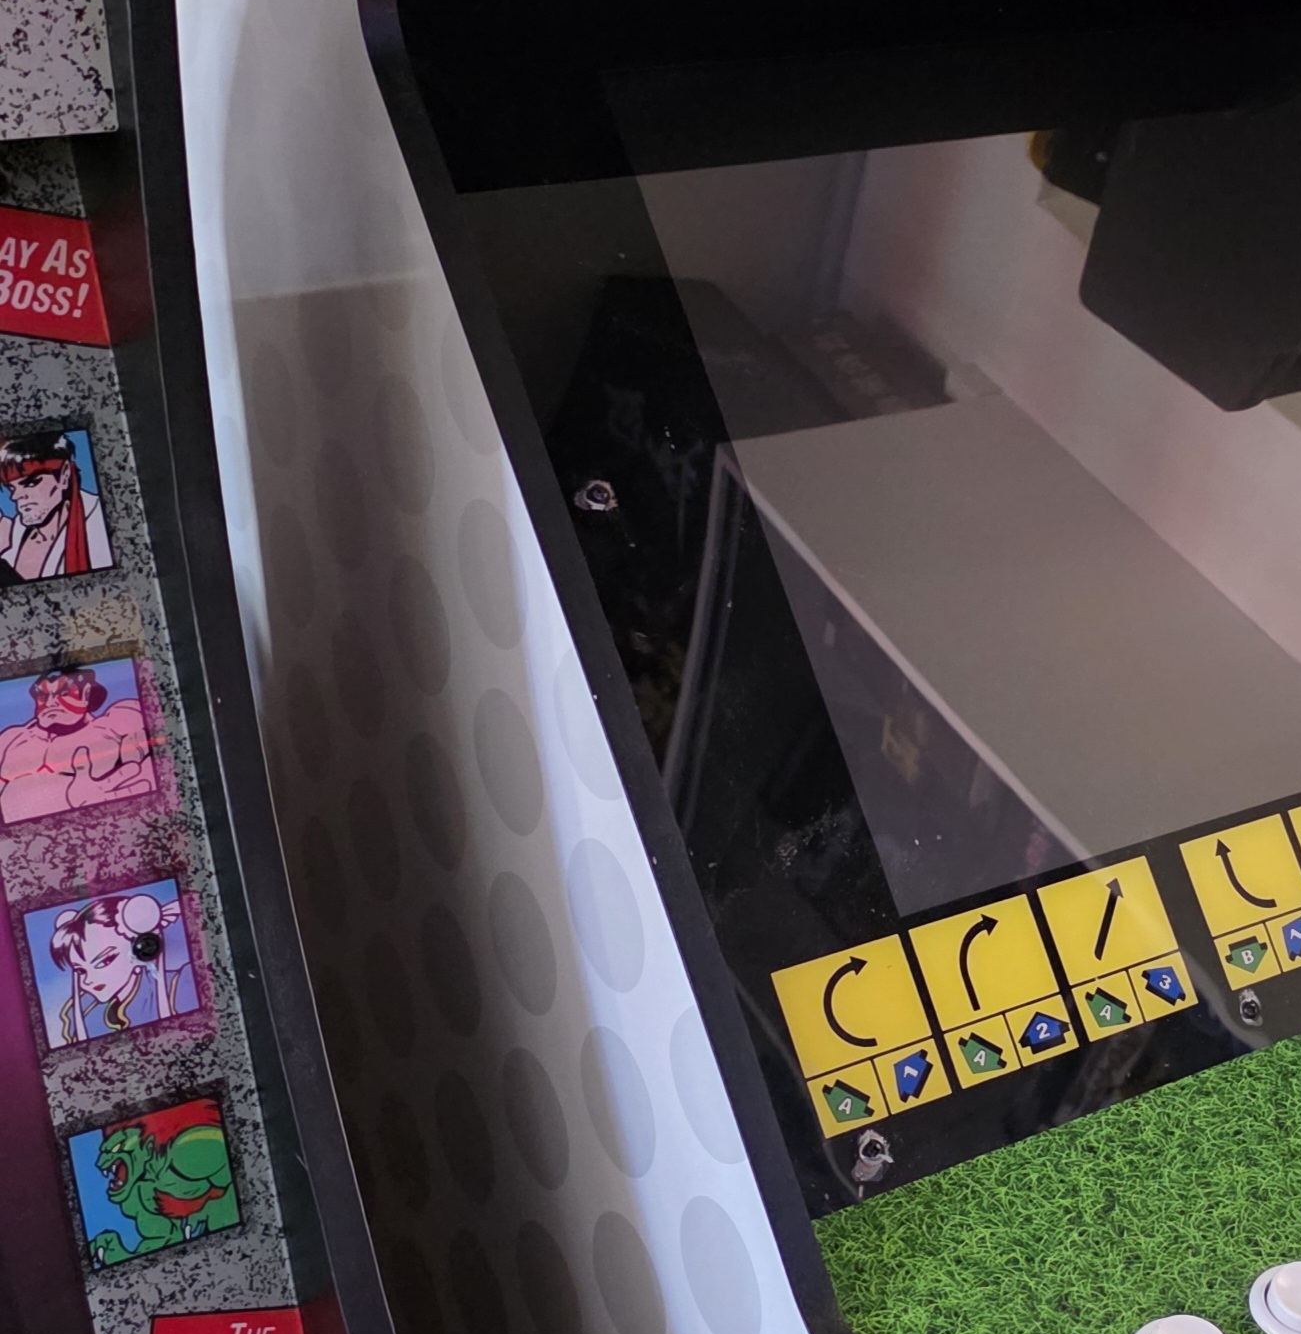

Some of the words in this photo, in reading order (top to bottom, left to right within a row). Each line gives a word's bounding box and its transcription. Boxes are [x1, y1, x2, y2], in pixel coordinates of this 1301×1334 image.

[1242, 950, 1255, 965] B
[1100, 1004, 1113, 1021] A
[1158, 975, 1172, 989] 3
[973, 1049, 988, 1066] A
[1037, 1022, 1049, 1039] 2
[838, 1097, 852, 1115] A
[903, 1065, 918, 1079] 1
